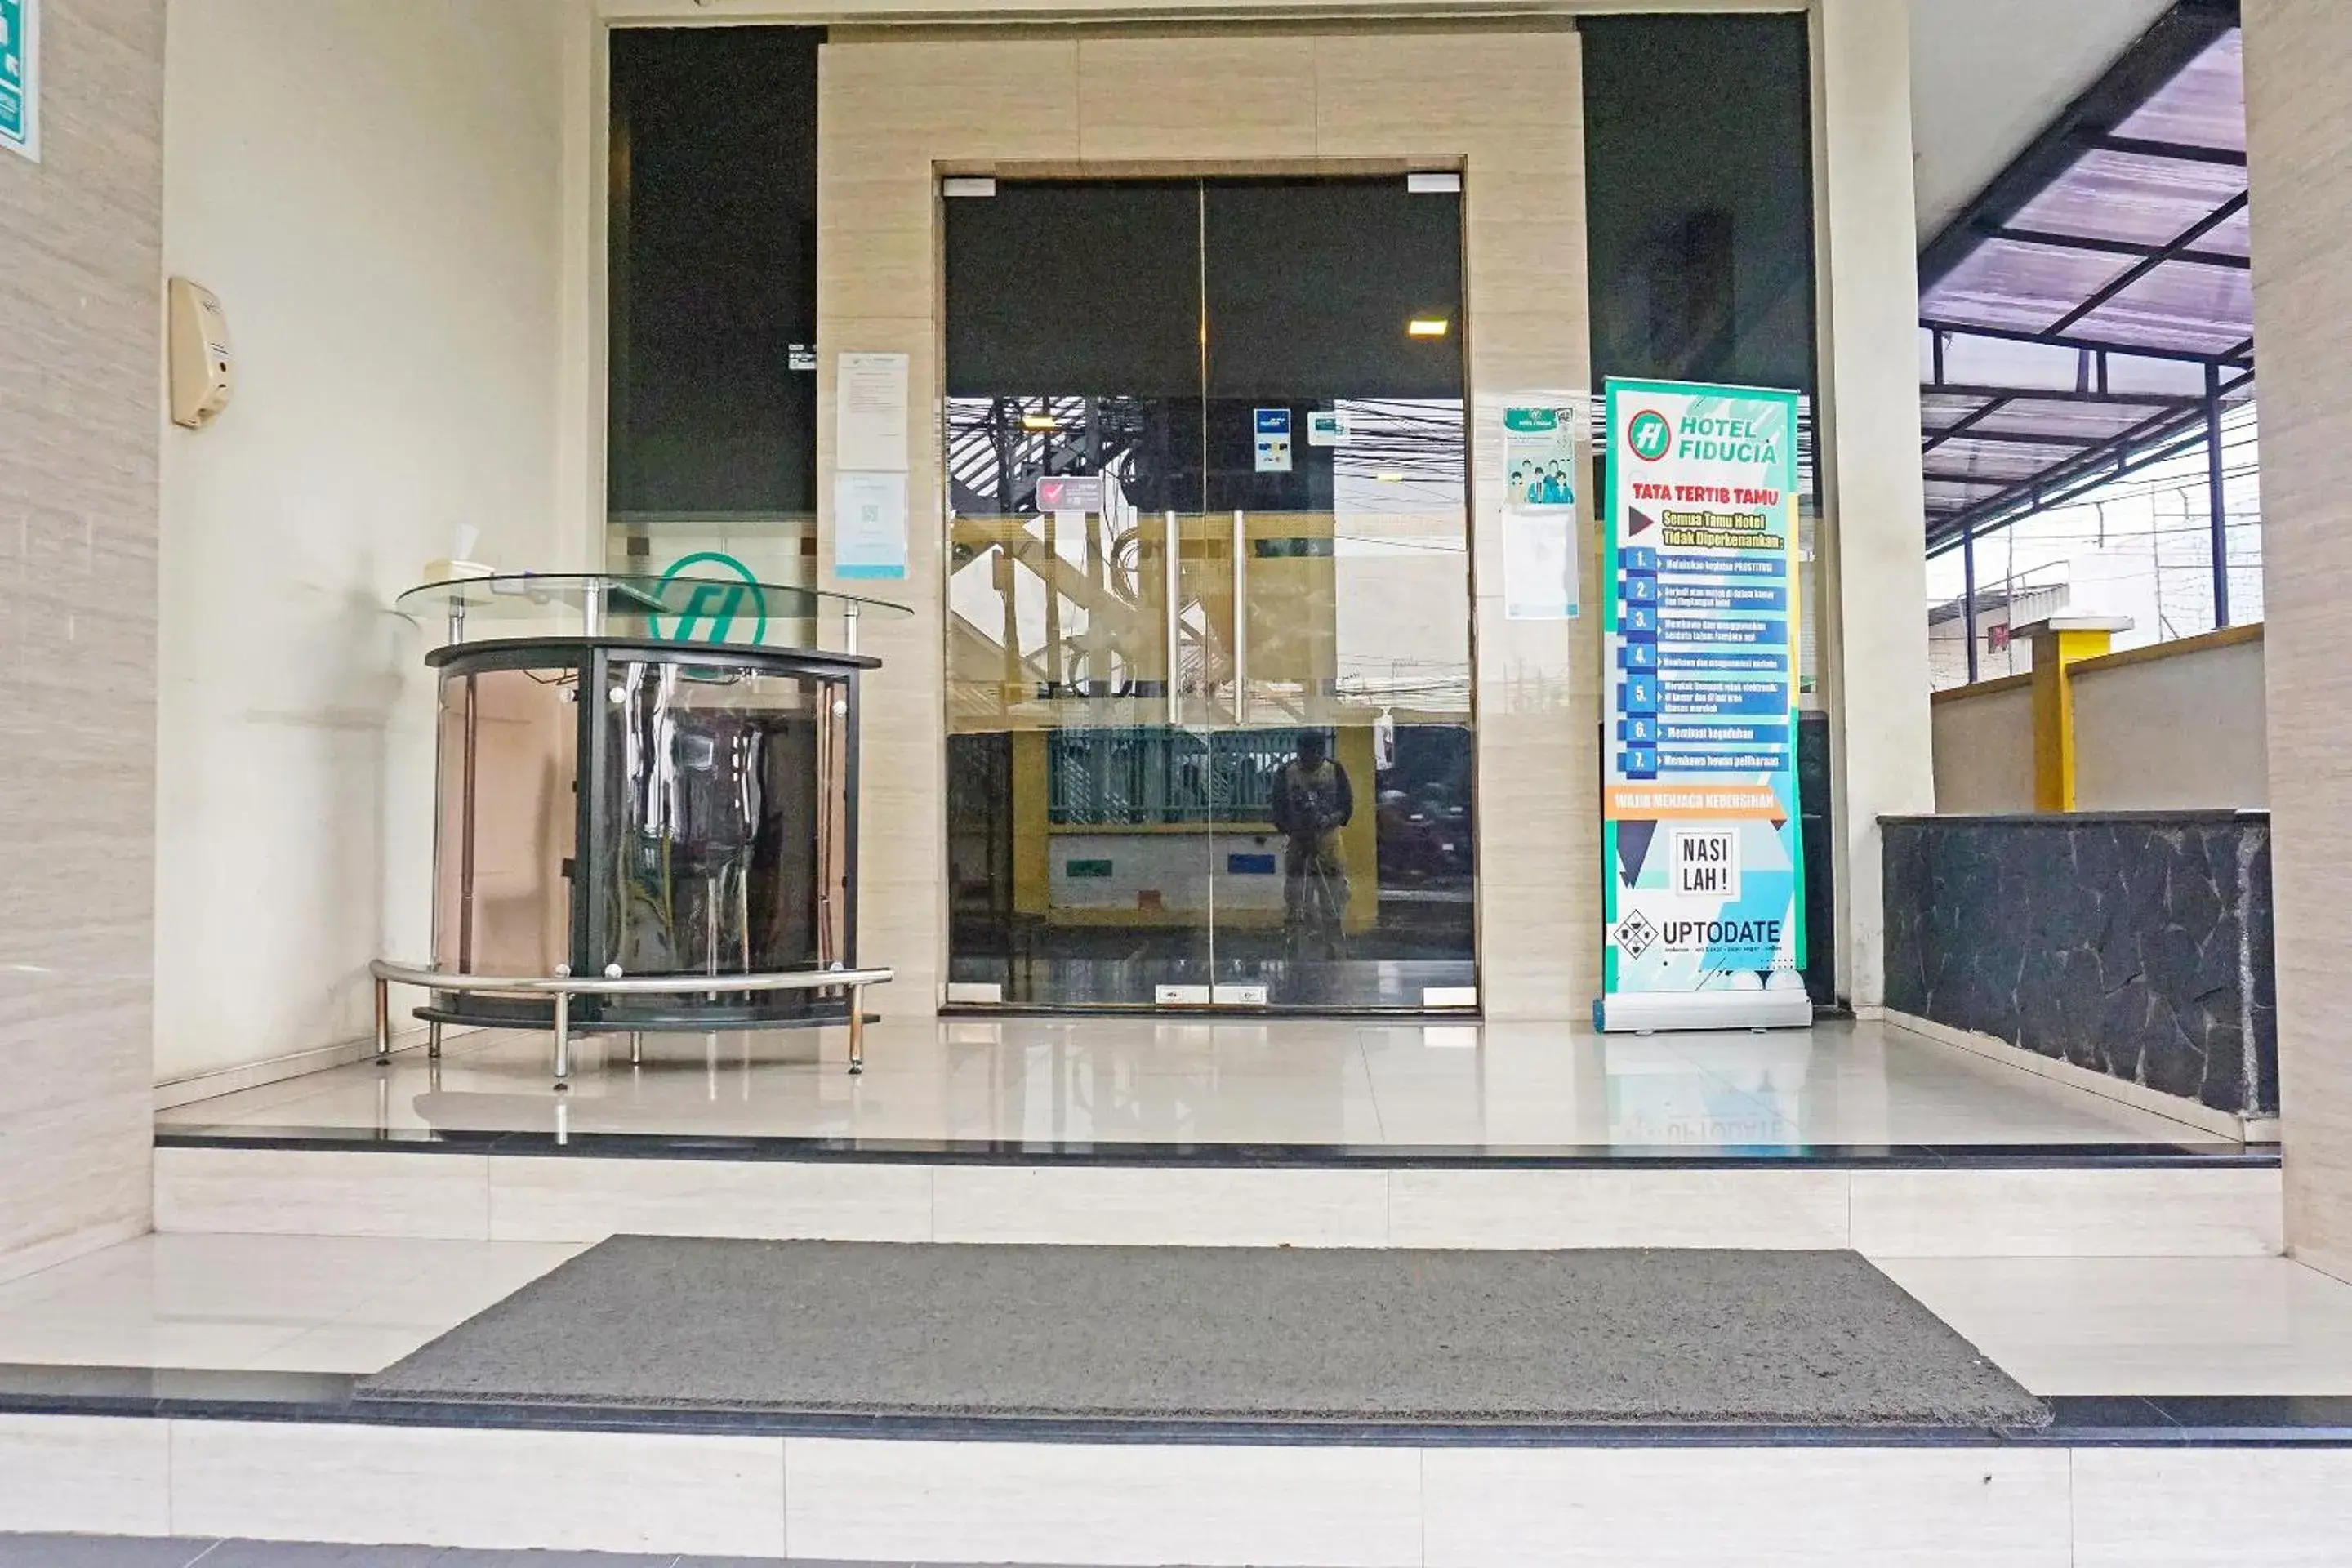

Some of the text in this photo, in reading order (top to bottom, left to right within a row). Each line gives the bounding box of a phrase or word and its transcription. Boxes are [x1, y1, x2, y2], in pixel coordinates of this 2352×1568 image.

[1679, 416, 1757, 439] HOTEL
[1679, 439, 1777, 464] FIDUCIA
[1633, 483, 1780, 506] TATA TERTIB TAMU
[1662, 510, 1766, 530] Semua Tamu Hotel
[1662, 529, 1695, 546] Tidak
[1683, 838, 1727, 862] NASI
[1664, 920, 1780, 944] UPTODATE
